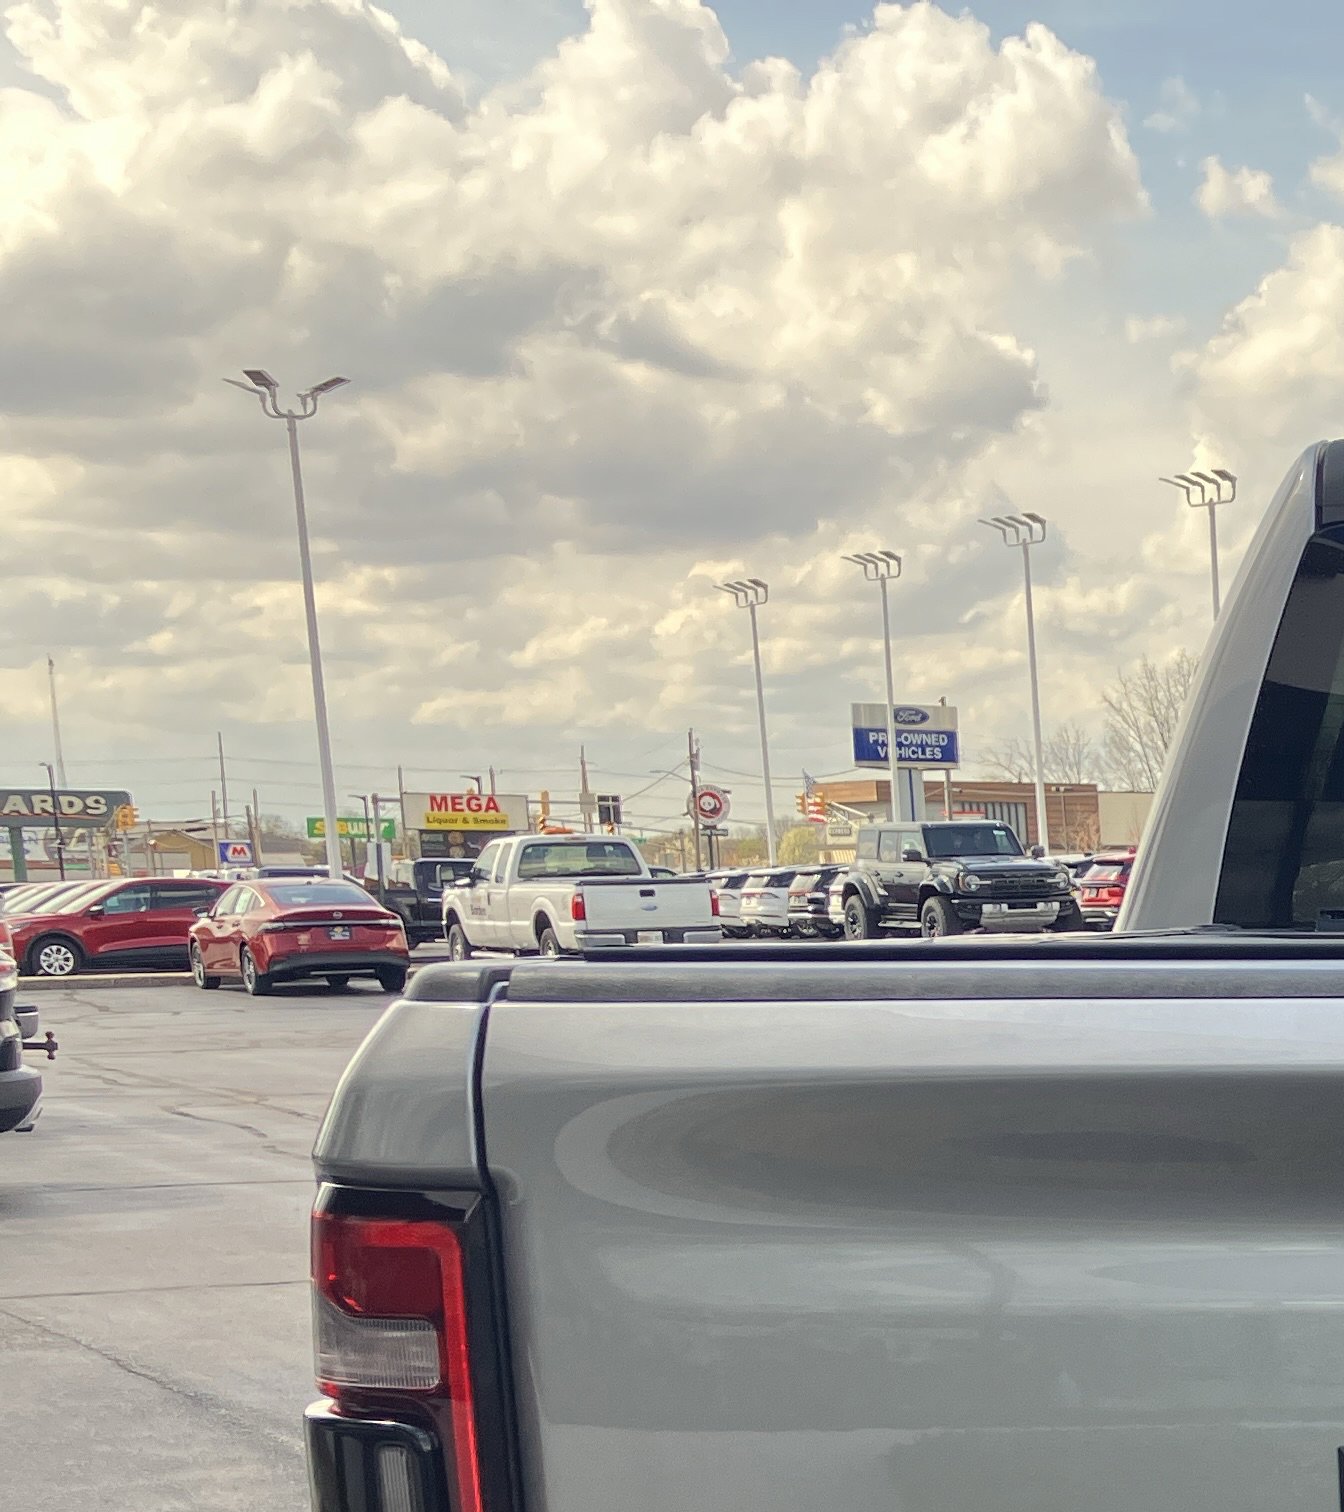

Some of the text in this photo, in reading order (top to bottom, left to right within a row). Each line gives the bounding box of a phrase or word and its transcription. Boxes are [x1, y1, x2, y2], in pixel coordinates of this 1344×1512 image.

[869, 732, 948, 746] PR-OWNED
[877, 746, 943, 759] VHICLES
[429, 795, 501, 813] MEGA
[426, 816, 458, 825] Liquor
[462, 816, 470, 824] &
